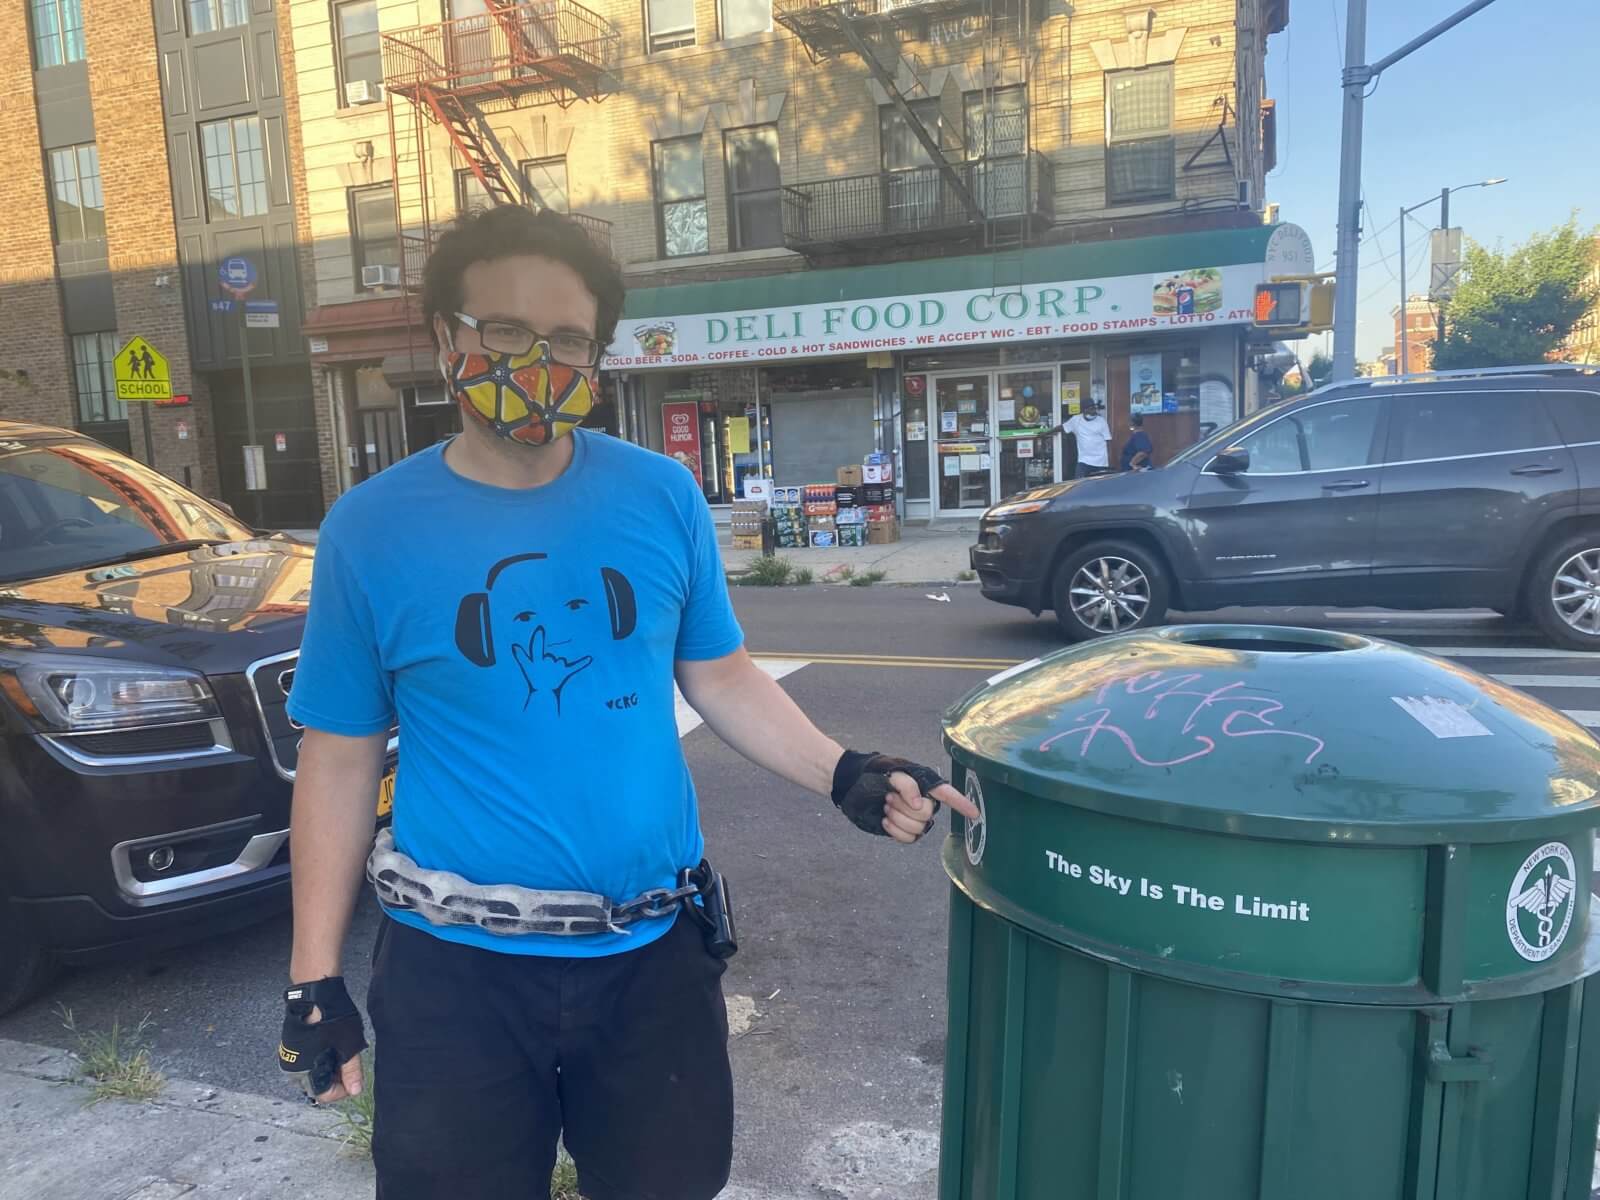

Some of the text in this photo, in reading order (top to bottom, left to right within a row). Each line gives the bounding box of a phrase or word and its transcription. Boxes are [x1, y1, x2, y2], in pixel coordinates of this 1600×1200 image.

[706, 285, 1120, 344] DELI FOOD CORP.
[605, 357, 632, 367] COLD
[635, 356, 662, 366] BEER
[671, 353, 699, 363] SODA
[707, 350, 750, 361] COFFEE
[758, 346, 787, 357] COLD
[790, 345, 799, 354] &
[802, 343, 825, 353] HOT
[828, 336, 906, 351] SANDWICHES
[916, 335, 935, 345] WE
[938, 330, 988, 343] ACCEPT
[991, 328, 1016, 339] WIC
[1026, 325, 1052, 336] EBT
[1063, 322, 1099, 333] FOOD
[1103, 317, 1158, 330] STAMPS
[1169, 312, 1215, 325] LOTTO
[120, 383, 169, 395] SCHOOL
[670, 433, 693, 442] HUMOR
[672, 425, 689, 434] GOOD
[1523, 846, 1571, 872] NEW YORK CITY
[1045, 850, 1310, 922] The Sky Is The Limit
[1509, 918, 1540, 958] DEPARTMENT
